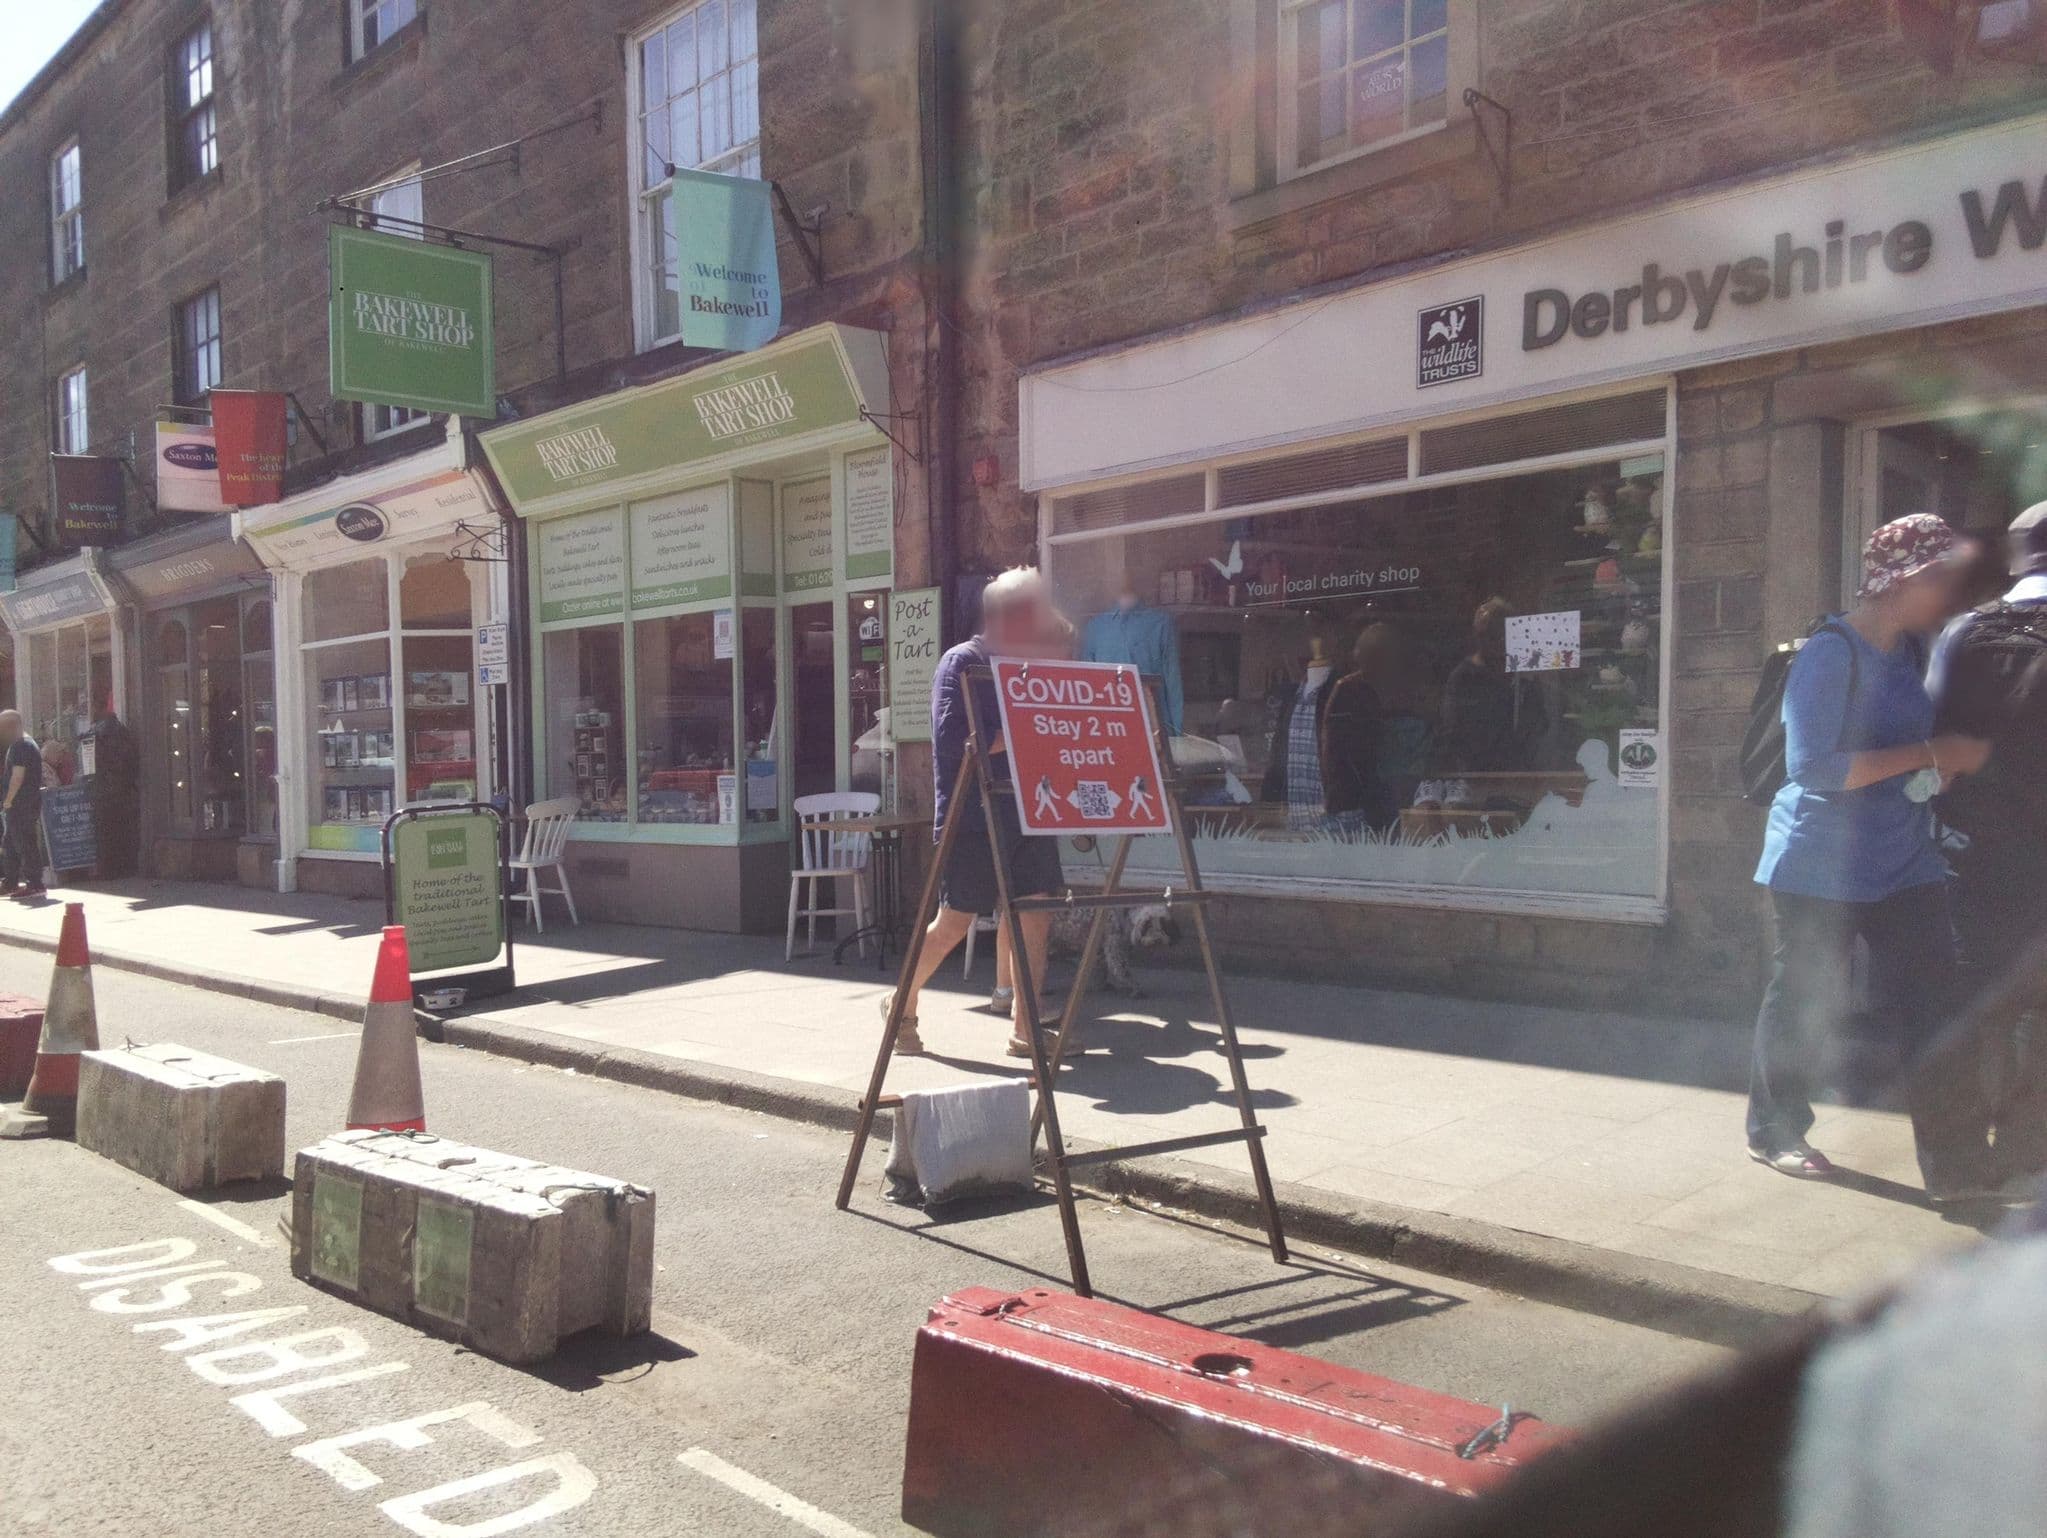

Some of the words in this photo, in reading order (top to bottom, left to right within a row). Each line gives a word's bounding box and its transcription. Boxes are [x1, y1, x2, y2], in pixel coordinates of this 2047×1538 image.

[690, 262, 768, 285] Welcome
[1522, 219, 1933, 352] Derbyshire
[689, 294, 770, 318] Bakewell
[751, 287, 769, 300] to
[354, 291, 472, 330] BAKEWELL
[353, 310, 412, 336] TART
[415, 320, 475, 346] SHOP
[1422, 339, 1478, 370] wildlife
[1422, 361, 1477, 382] TRUSTS
[694, 375, 788, 418] BAKEWELL
[701, 408, 746, 438] TART
[745, 395, 794, 427] SHOP
[168, 451, 202, 461] Saxton
[536, 427, 611, 462] BAKEWELL
[543, 454, 582, 479] TART
[578, 444, 617, 471] SHOP
[1246, 581, 1278, 597] Your
[1282, 574, 1316, 593] local
[1321, 569, 1374, 589] charity
[1379, 565, 1420, 584] shop
[895, 598, 933, 621] Post
[894, 638, 936, 660] Tart
[1007, 676, 1133, 707] COVID-19
[1034, 714, 1081, 740] Stay
[1087, 716, 1101, 736] 2
[1107, 720, 1127, 737] m
[1059, 747, 1115, 769] apart
[412, 879, 447, 890] Home
[449, 872, 464, 886] of
[414, 883, 486, 901] traditional
[407, 899, 462, 915] Bakewell
[465, 896, 490, 907] Tart
[47, 1236, 600, 1538] DISABLED
